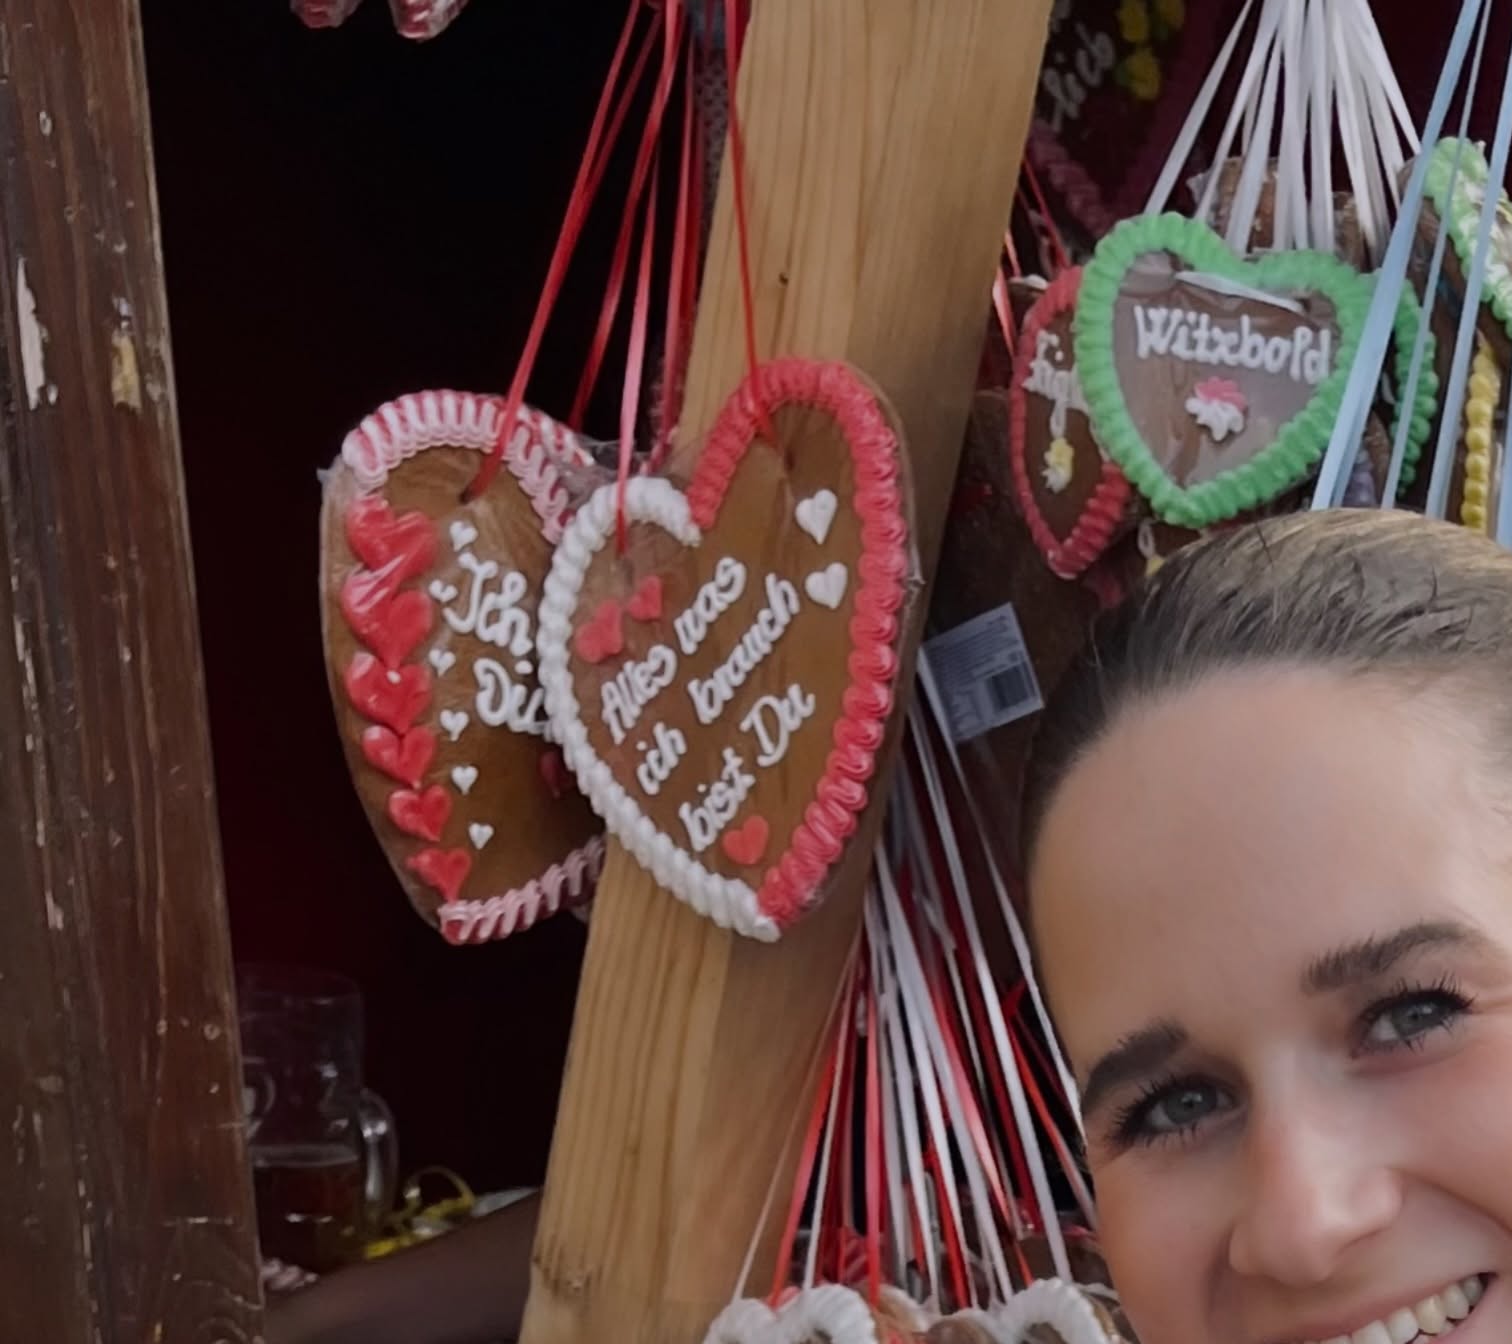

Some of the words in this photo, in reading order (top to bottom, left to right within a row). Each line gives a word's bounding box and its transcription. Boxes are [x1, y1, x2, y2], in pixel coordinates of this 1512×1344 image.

[1134, 305, 1331, 385] Witzbold
[443, 552, 533, 657] Ich
[601, 645, 678, 745] Alles
[674, 556, 747, 655] was
[636, 721, 688, 796] ich
[687, 573, 801, 725] brauch
[678, 748, 756, 852] bist
[740, 684, 816, 768] Du
